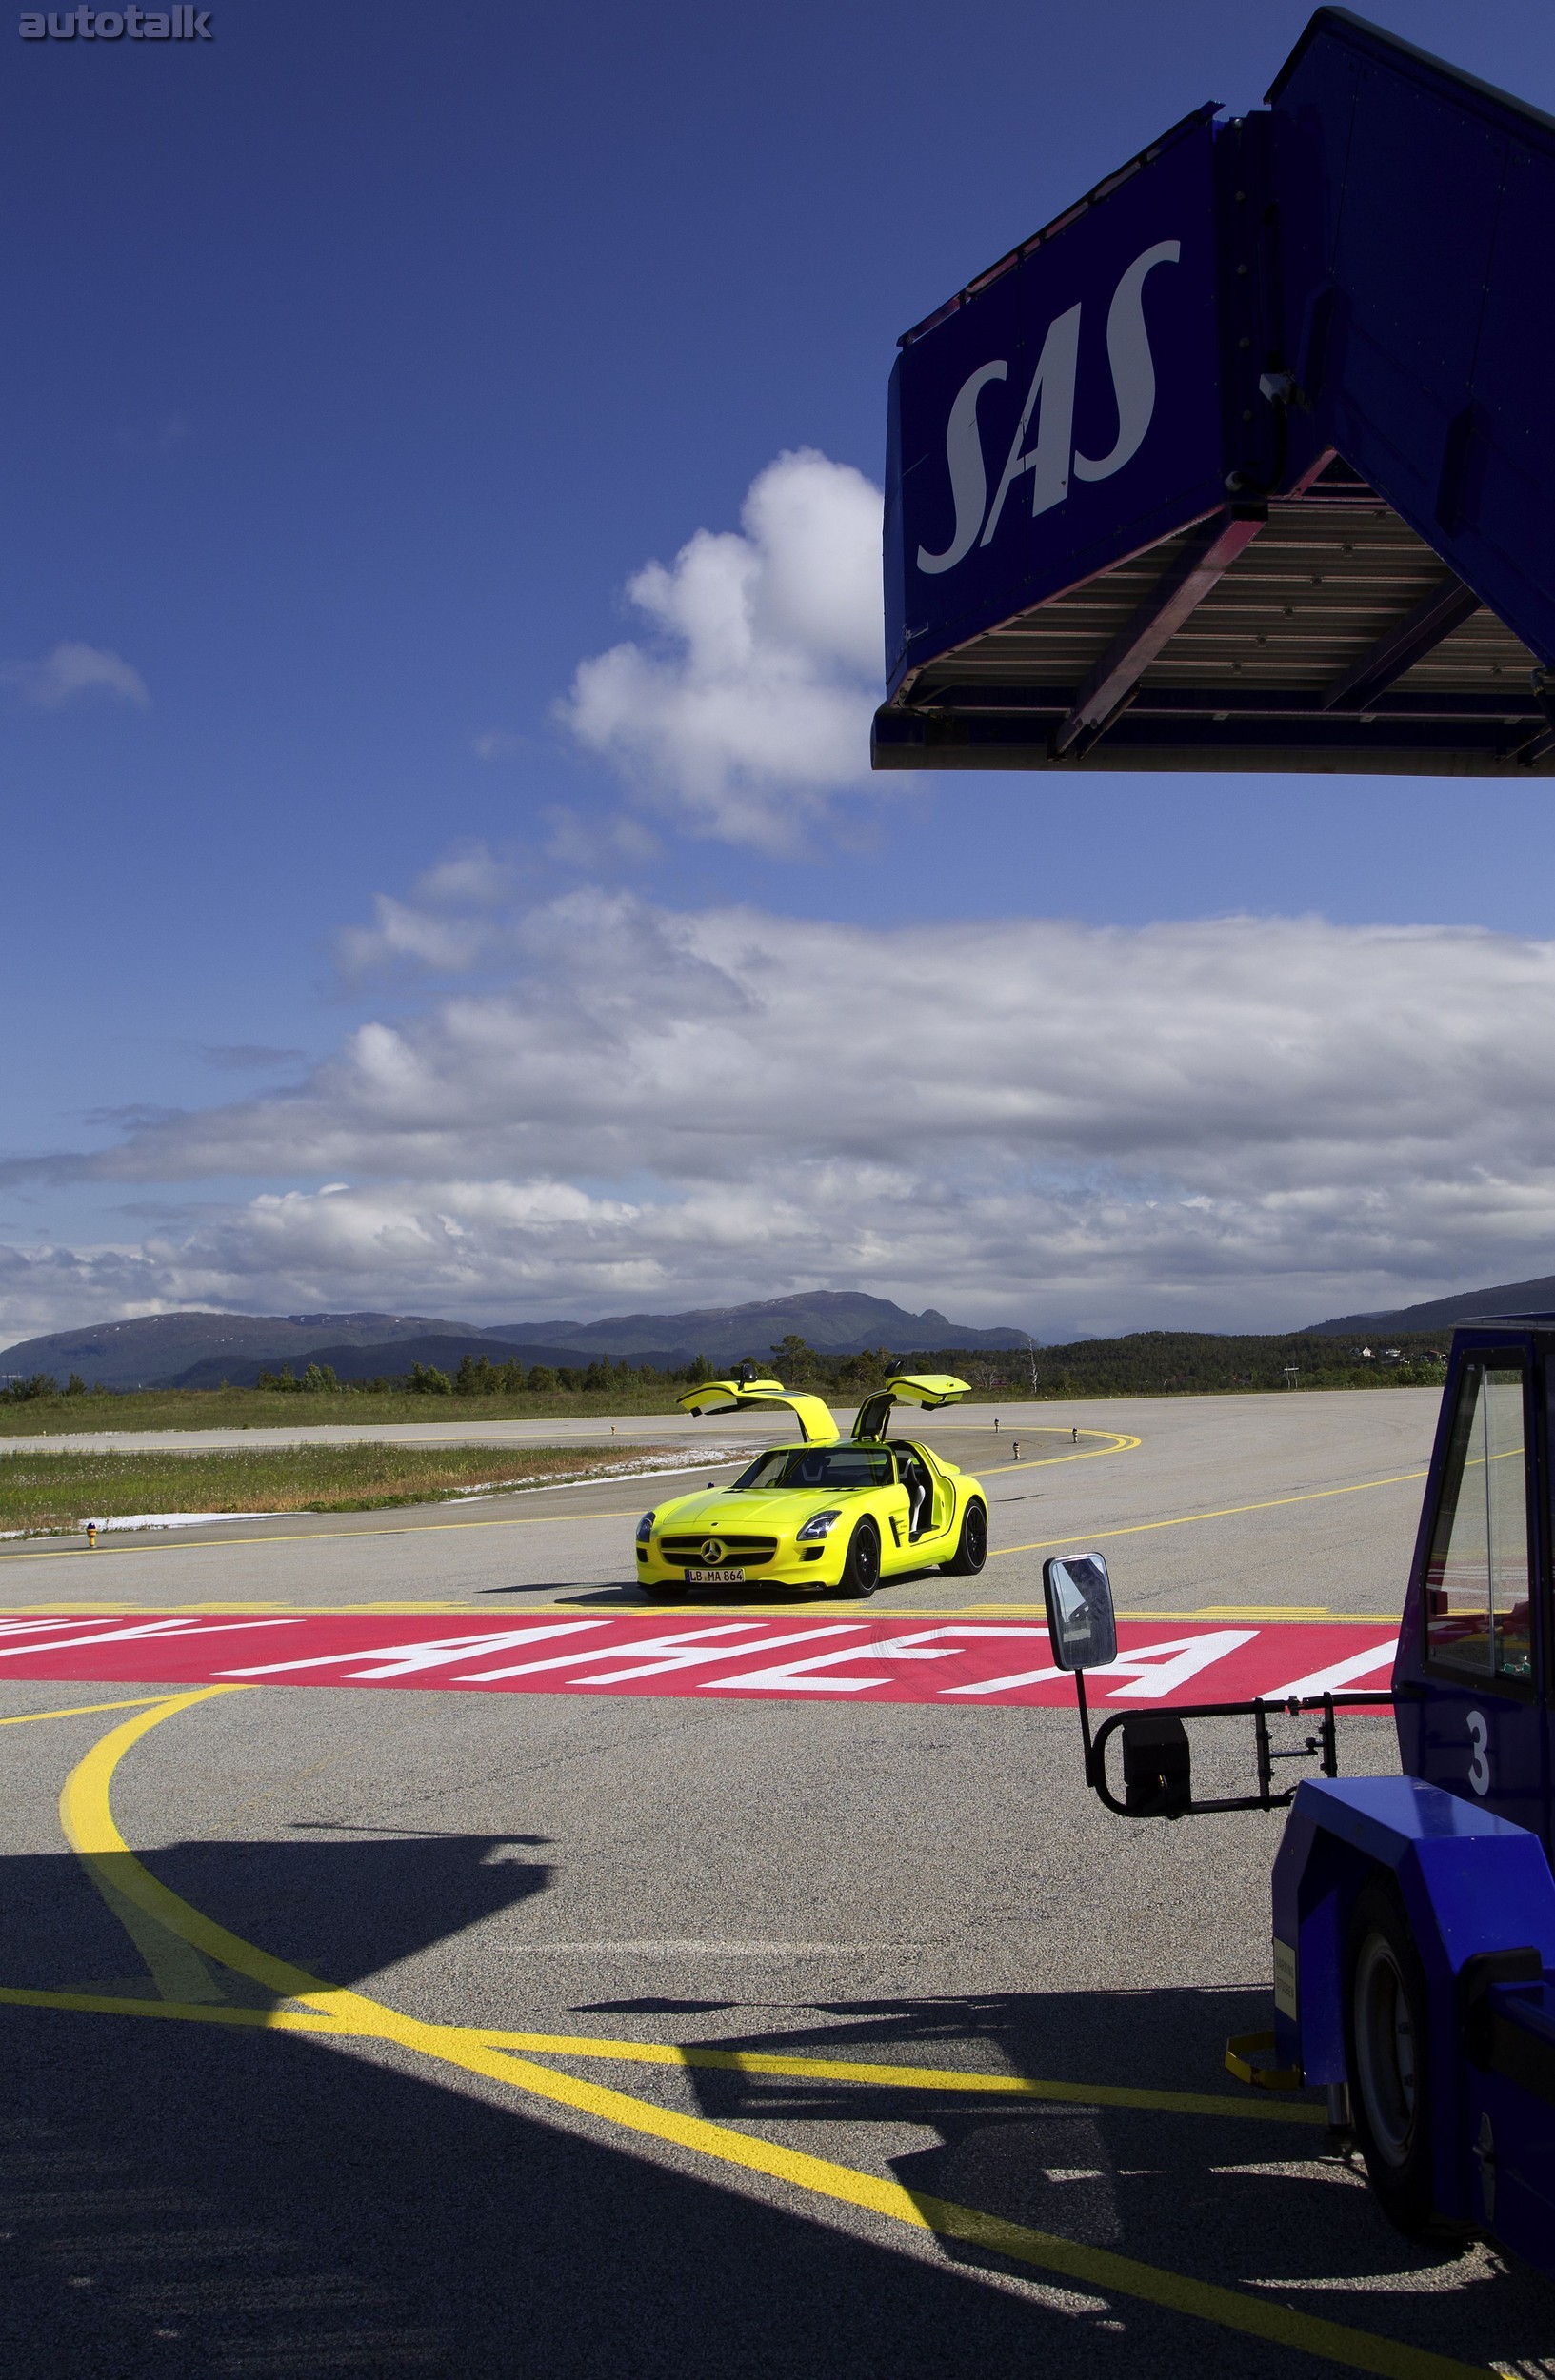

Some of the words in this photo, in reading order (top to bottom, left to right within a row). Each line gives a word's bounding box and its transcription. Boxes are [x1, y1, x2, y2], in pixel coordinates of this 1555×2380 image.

[917, 240, 1181, 574] SAS
[690, 1571, 703, 1581] LB
[708, 1571, 721, 1581] MA
[724, 1571, 743, 1581] 864
[1466, 1710, 1490, 1796] 3
